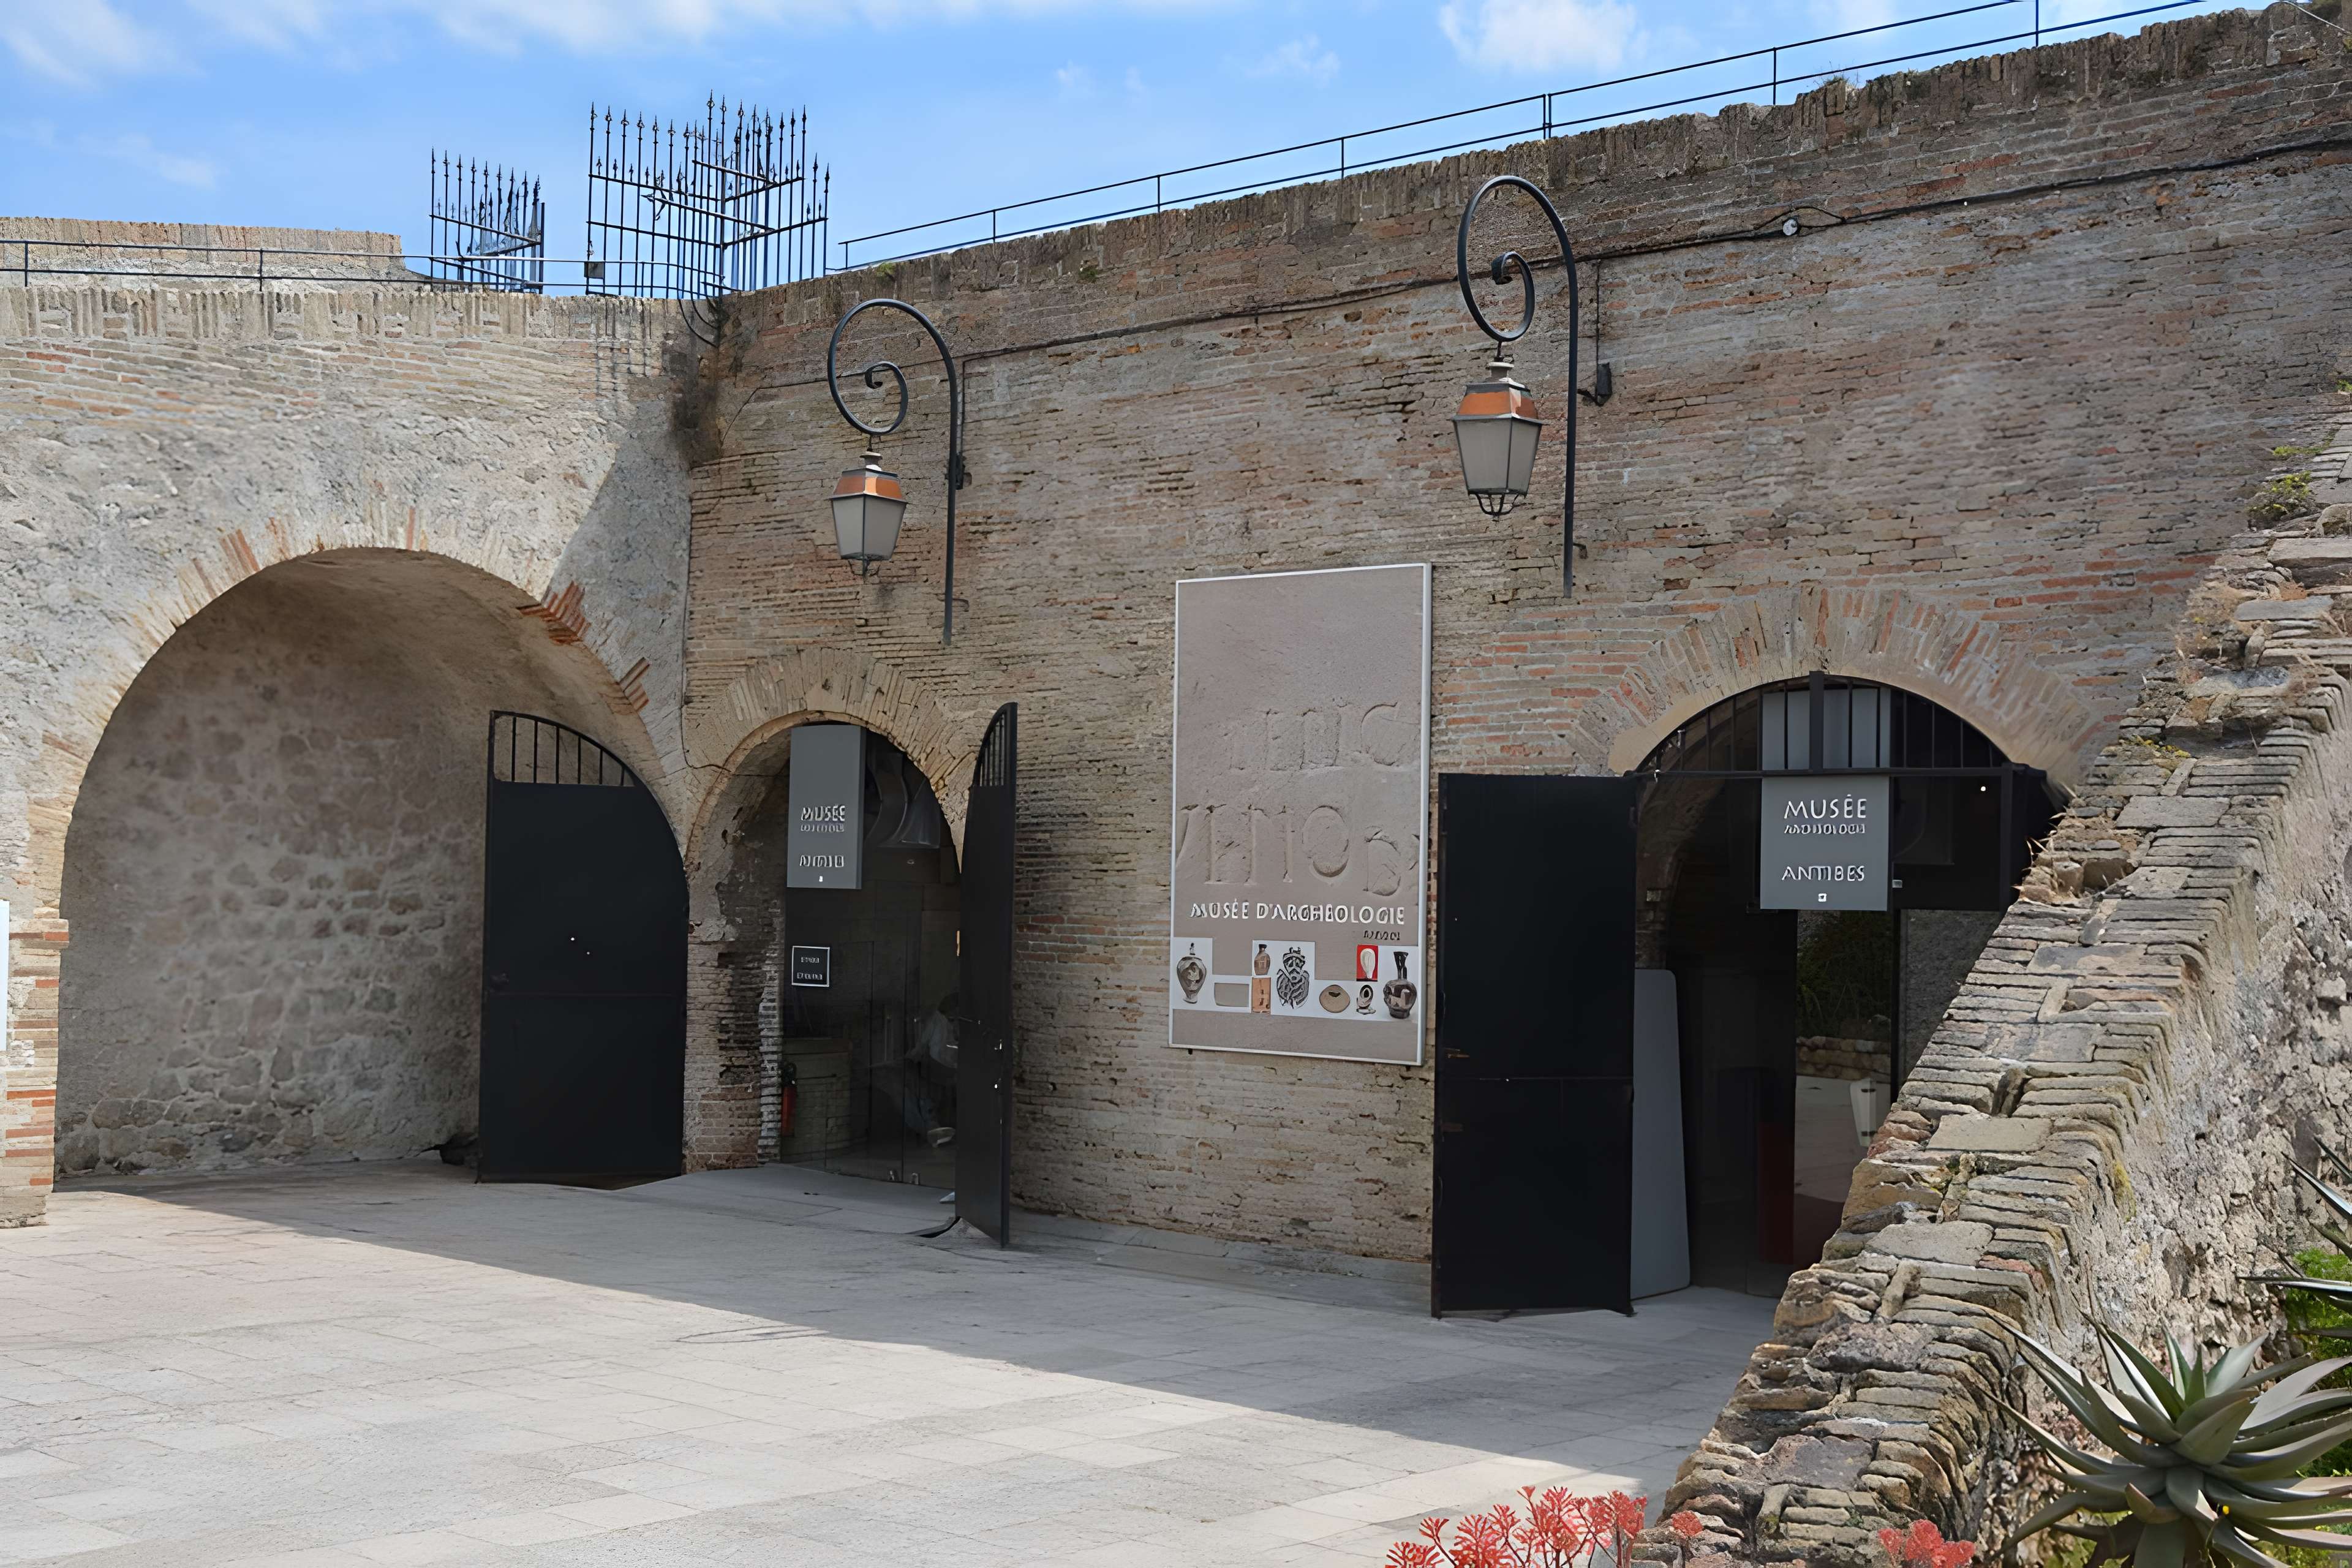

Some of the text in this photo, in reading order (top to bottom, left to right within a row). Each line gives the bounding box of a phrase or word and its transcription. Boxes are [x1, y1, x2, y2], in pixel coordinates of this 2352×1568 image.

[1784, 794, 1867, 819] MUSÉE
[1782, 865, 1864, 881] ANTIBES
[1190, 898, 1250, 919] MUSÉE
